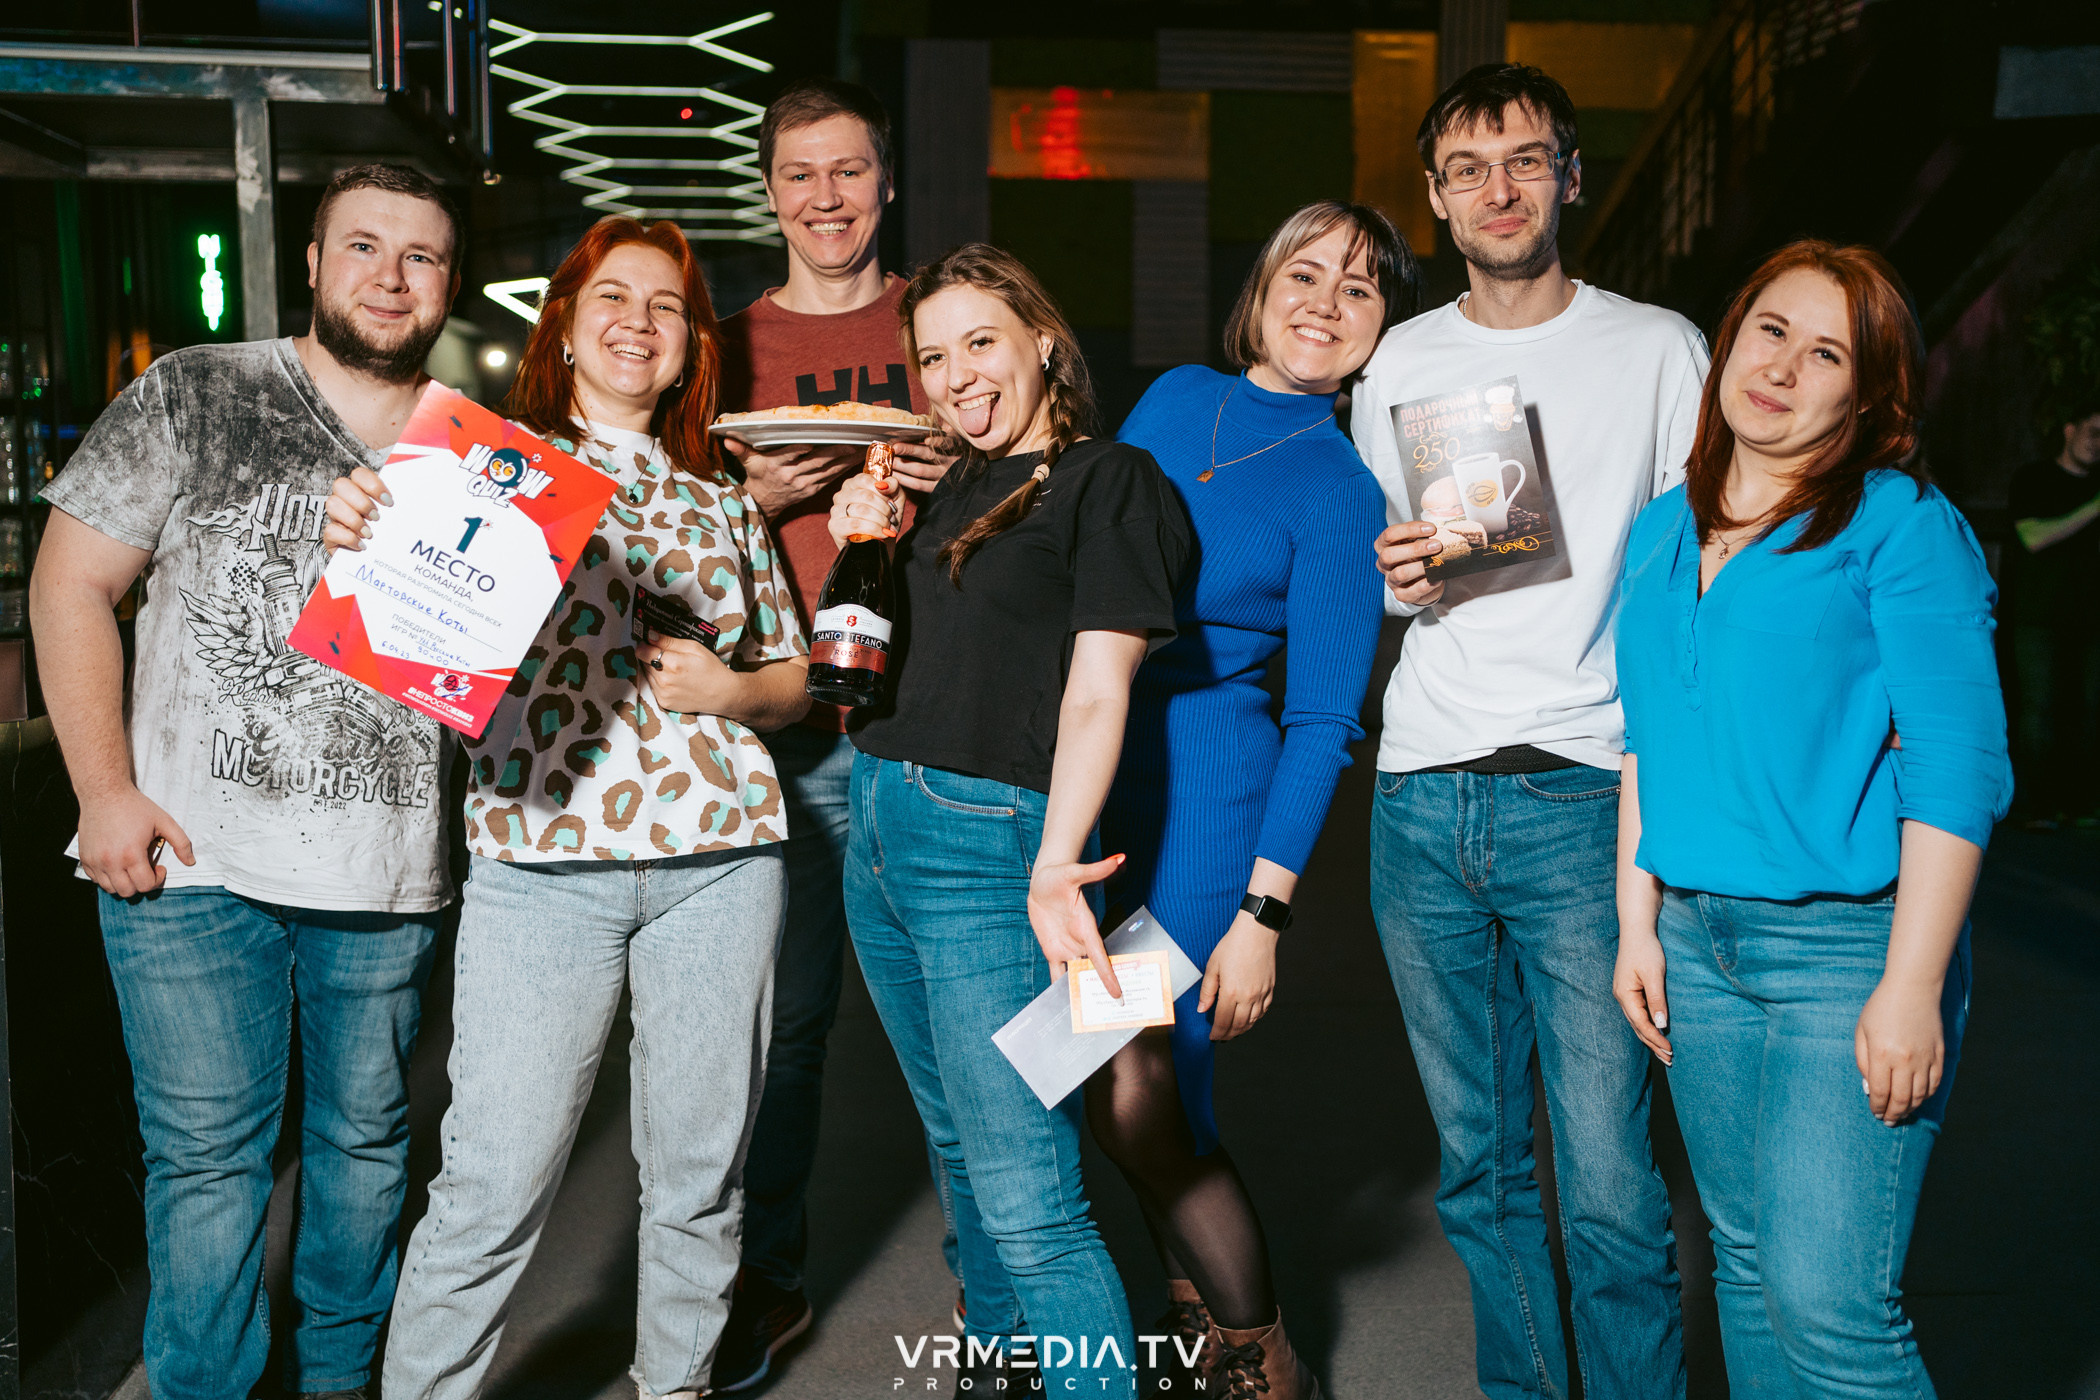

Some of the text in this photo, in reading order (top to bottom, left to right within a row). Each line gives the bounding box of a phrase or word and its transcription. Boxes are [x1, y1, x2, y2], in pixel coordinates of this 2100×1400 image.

[1403, 407, 1482, 438] СЕРТИФИКАТ
[1413, 437, 1461, 468] 250
[467, 474, 519, 508] QUIZ
[456, 516, 483, 554] 1
[410, 539, 495, 592] МЕСТО
[355, 564, 469, 635] Мартовские Коты
[373, 558, 502, 629] КОТОРАЯ РАЗГРОМИЛА СЕГОДНЯ ВСЕХ
[391, 623, 408, 634] ИГР
[391, 613, 447, 645] ПОБЕДИТЕЛИ
[817, 632, 882, 649] SANTO STEFANO
[211, 728, 437, 808] MOTORCYCLE
